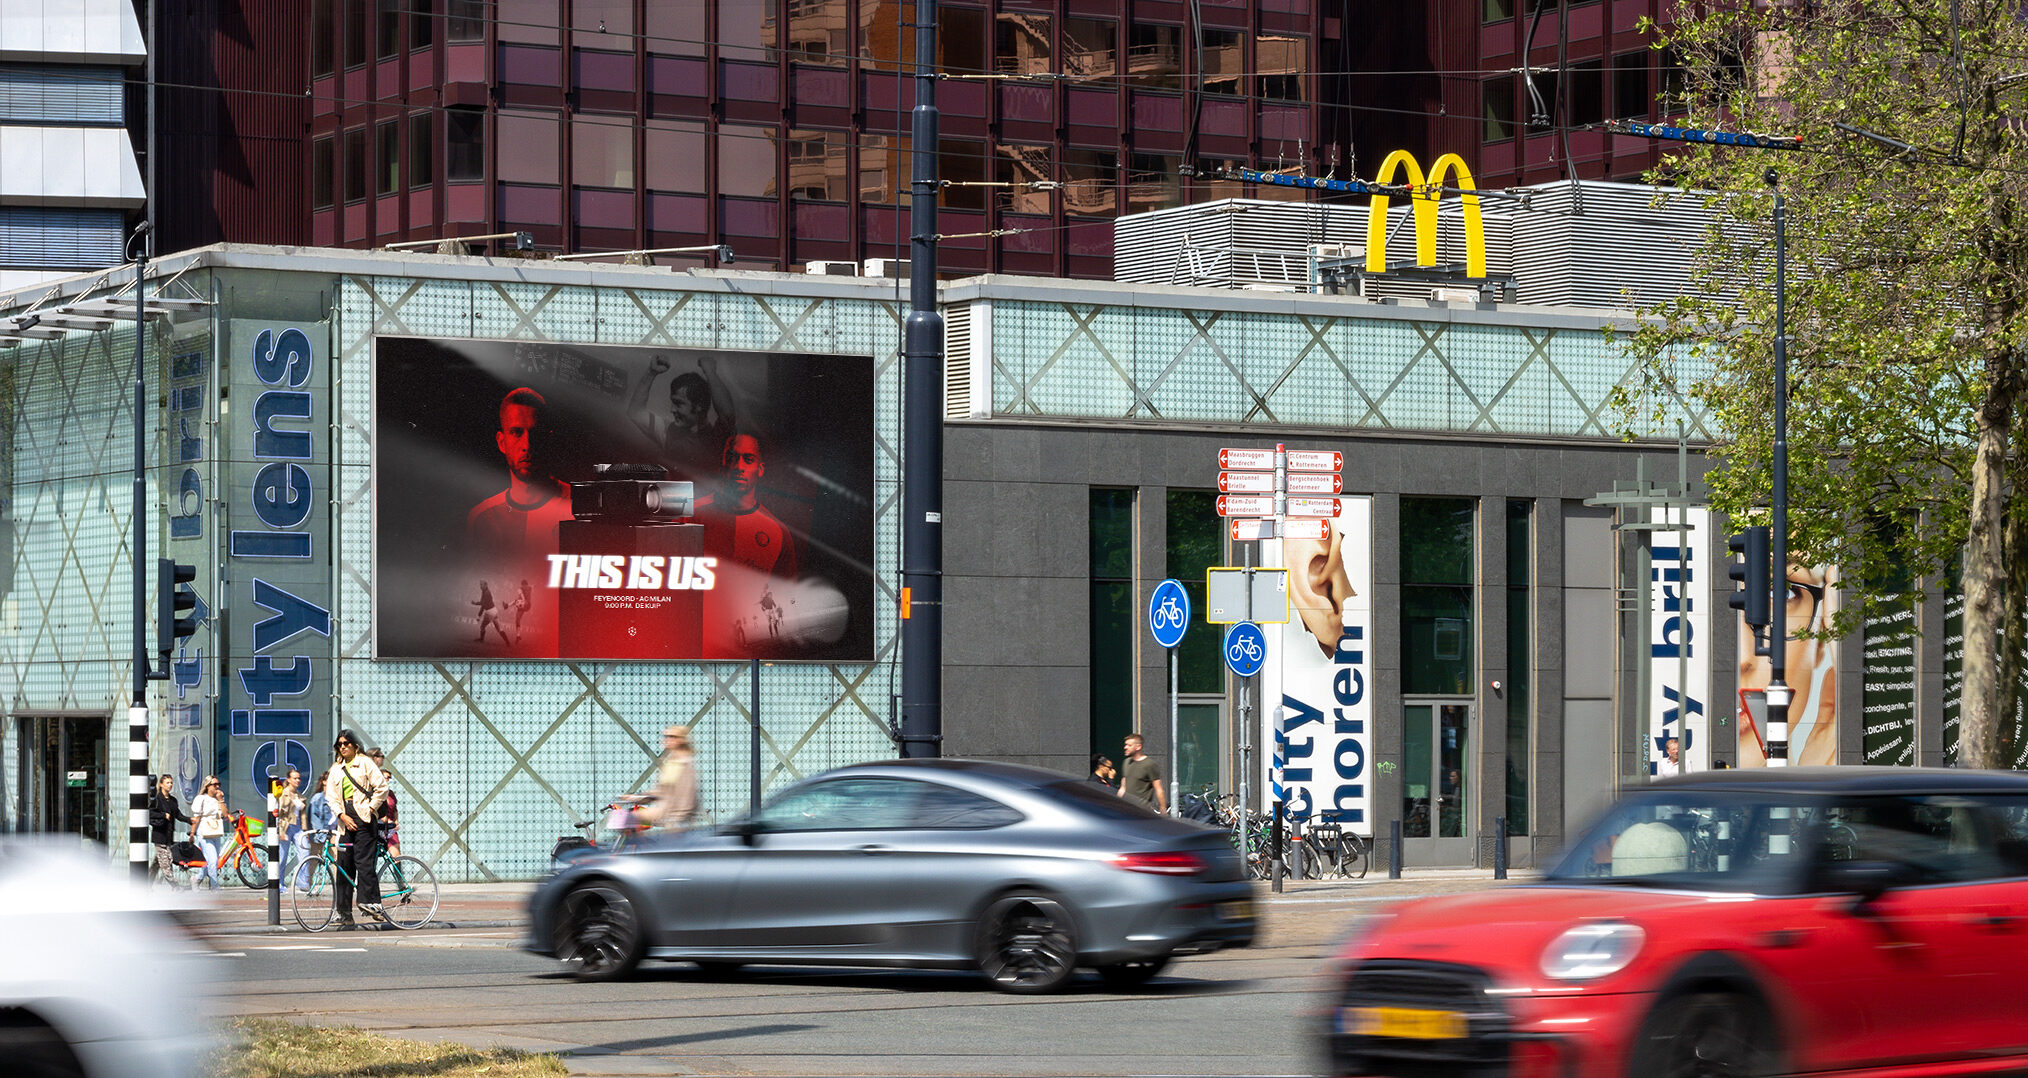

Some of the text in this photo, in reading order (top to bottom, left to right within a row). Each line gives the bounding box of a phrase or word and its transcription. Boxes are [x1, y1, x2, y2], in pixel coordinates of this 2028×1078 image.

[1228, 451, 1265, 459] Maasbruggen
[169, 351, 210, 805] city bril
[231, 327, 331, 802] city lens
[546, 554, 626, 589] THIS
[625, 555, 666, 590] IS
[667, 556, 718, 591] US
[1651, 546, 1694, 658] bril
[1269, 693, 1325, 825] city
[1321, 626, 1364, 823] horen
